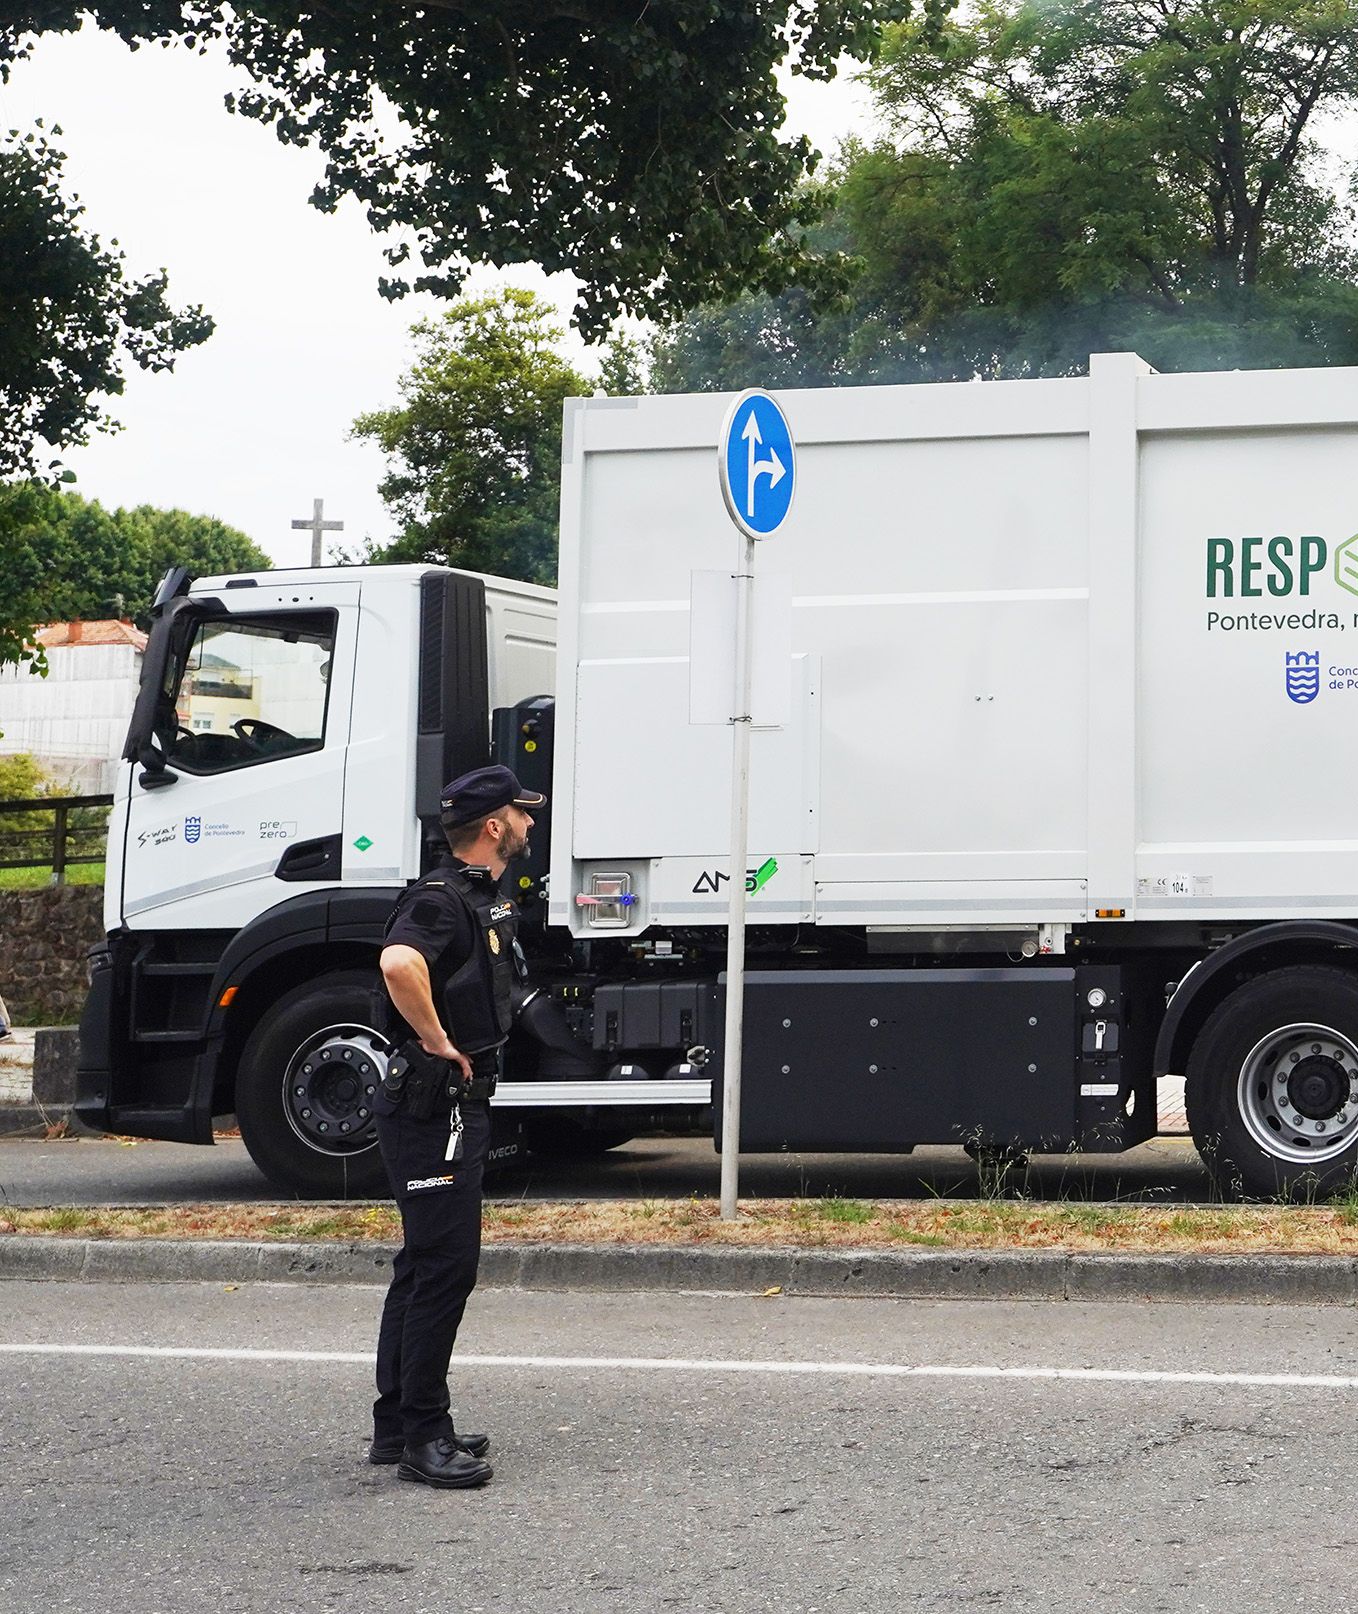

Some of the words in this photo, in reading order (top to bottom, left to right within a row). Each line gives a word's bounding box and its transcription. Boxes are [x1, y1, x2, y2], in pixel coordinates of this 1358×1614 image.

[1207, 608, 1345, 631] Pontevedra,
[1329, 679, 1344, 690] de
[259, 821, 280, 830] pre
[212, 829, 245, 837] Pontevedra
[259, 831, 287, 839] zero
[1172, 881, 1184, 893] 104
[488, 1144, 518, 1160] IVECO
